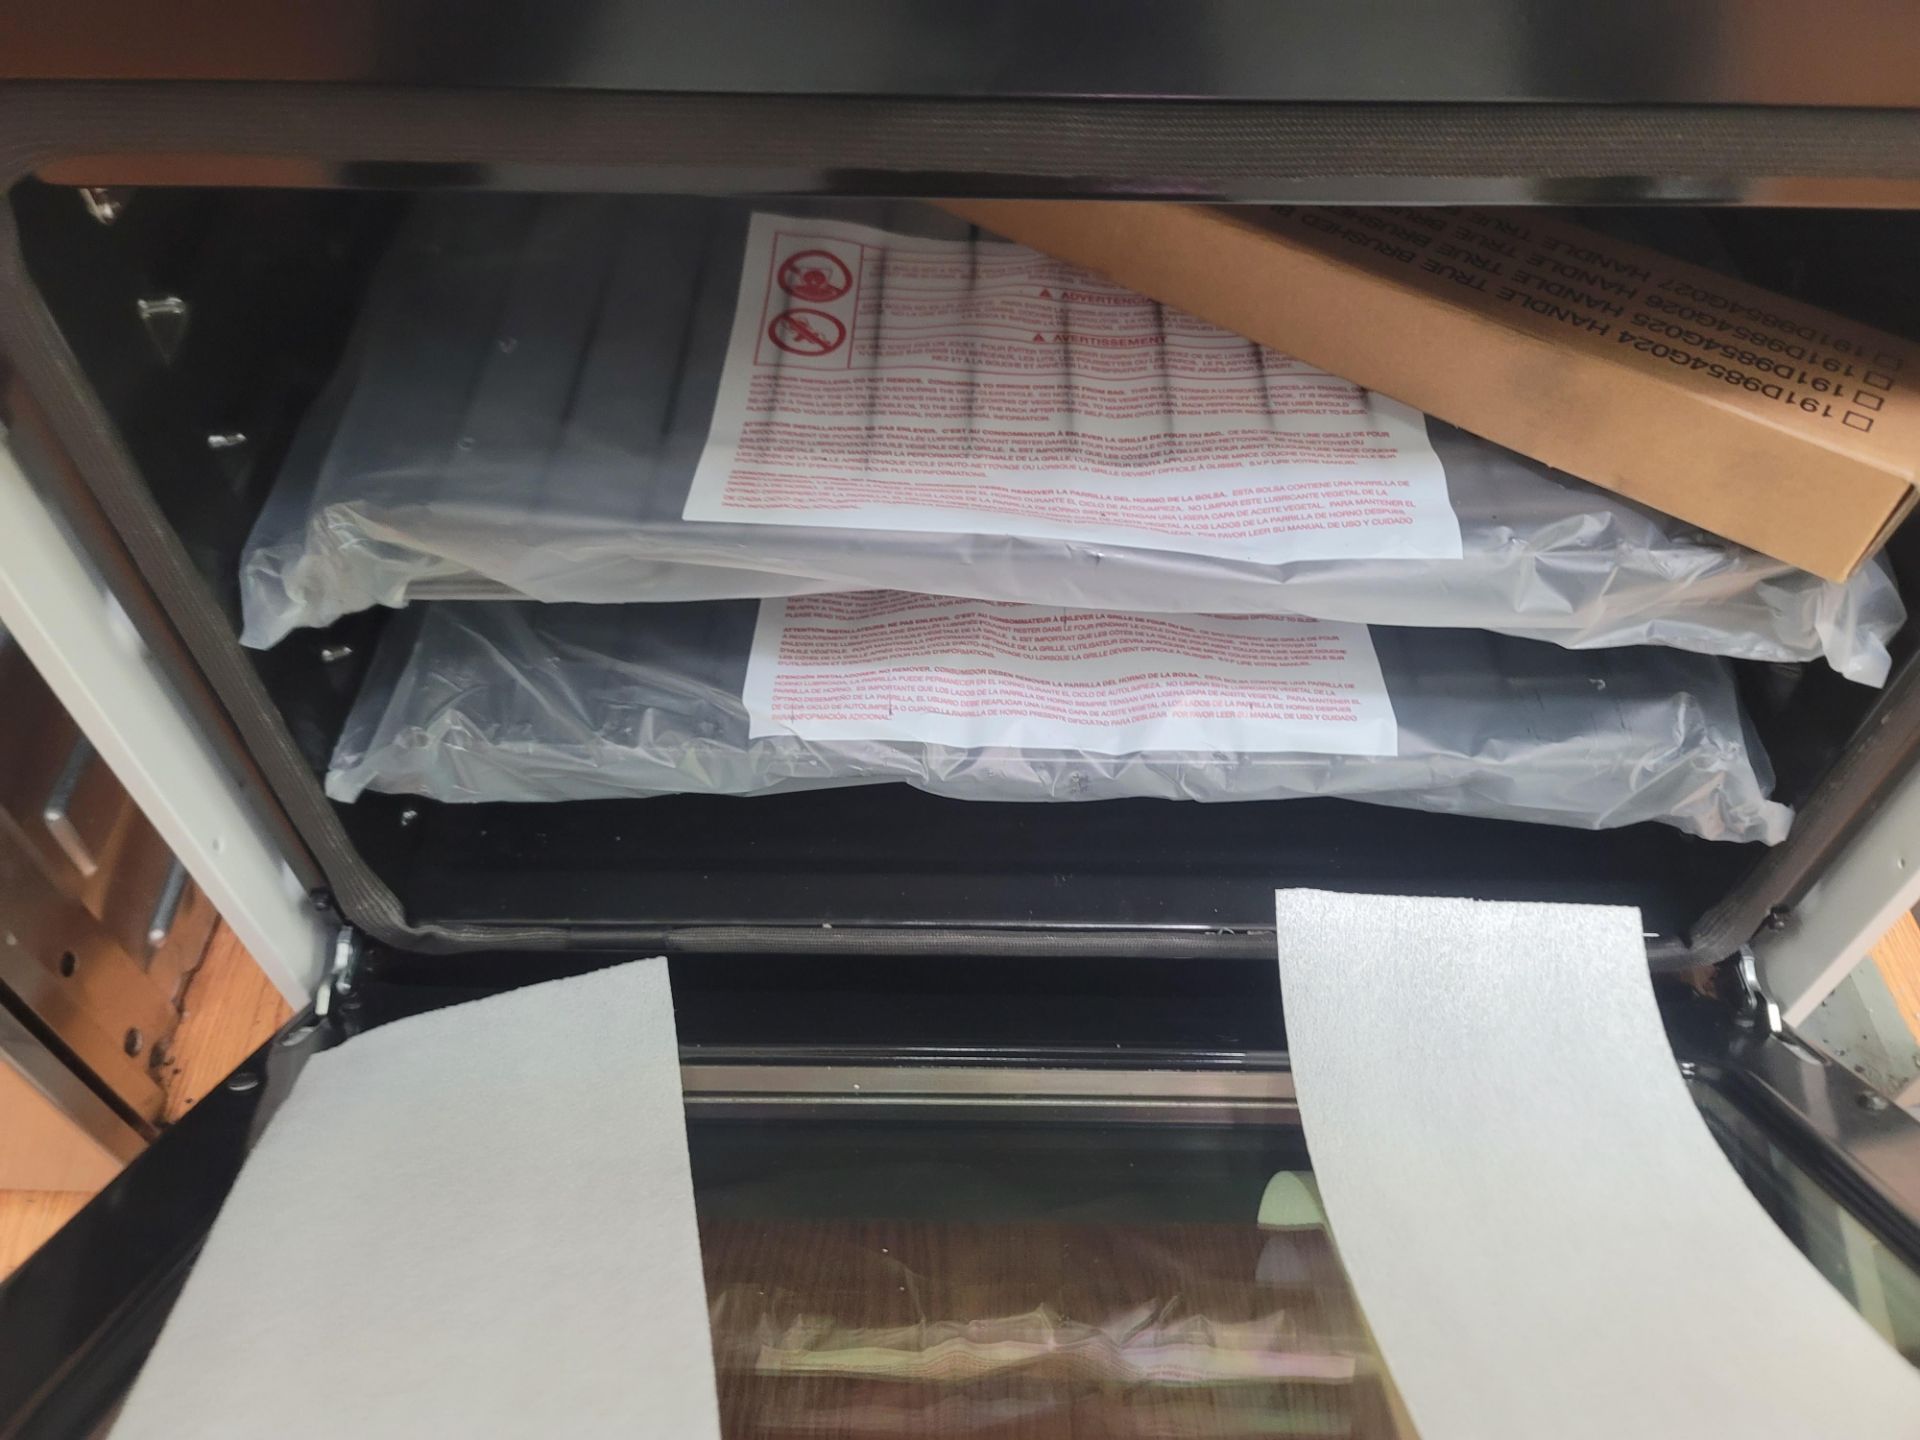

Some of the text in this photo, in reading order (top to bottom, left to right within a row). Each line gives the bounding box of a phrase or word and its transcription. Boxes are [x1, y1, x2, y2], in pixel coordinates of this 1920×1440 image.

[1301, 214, 1417, 264] BRUSHED
[1437, 241, 1503, 275] TRUE
[1541, 234, 1652, 282] HANDLE
[1420, 258, 1489, 292] TRUE
[1511, 269, 1625, 317] HANDLE
[1455, 225, 1854, 377] 191D9854G026 HANDLE TRUE
[1496, 286, 1611, 336] HANDLE
[1658, 278, 1864, 357] 191D9854G027
[1618, 330, 1833, 418] 191D9854G024
[1630, 312, 1844, 397] 191D9854G025
